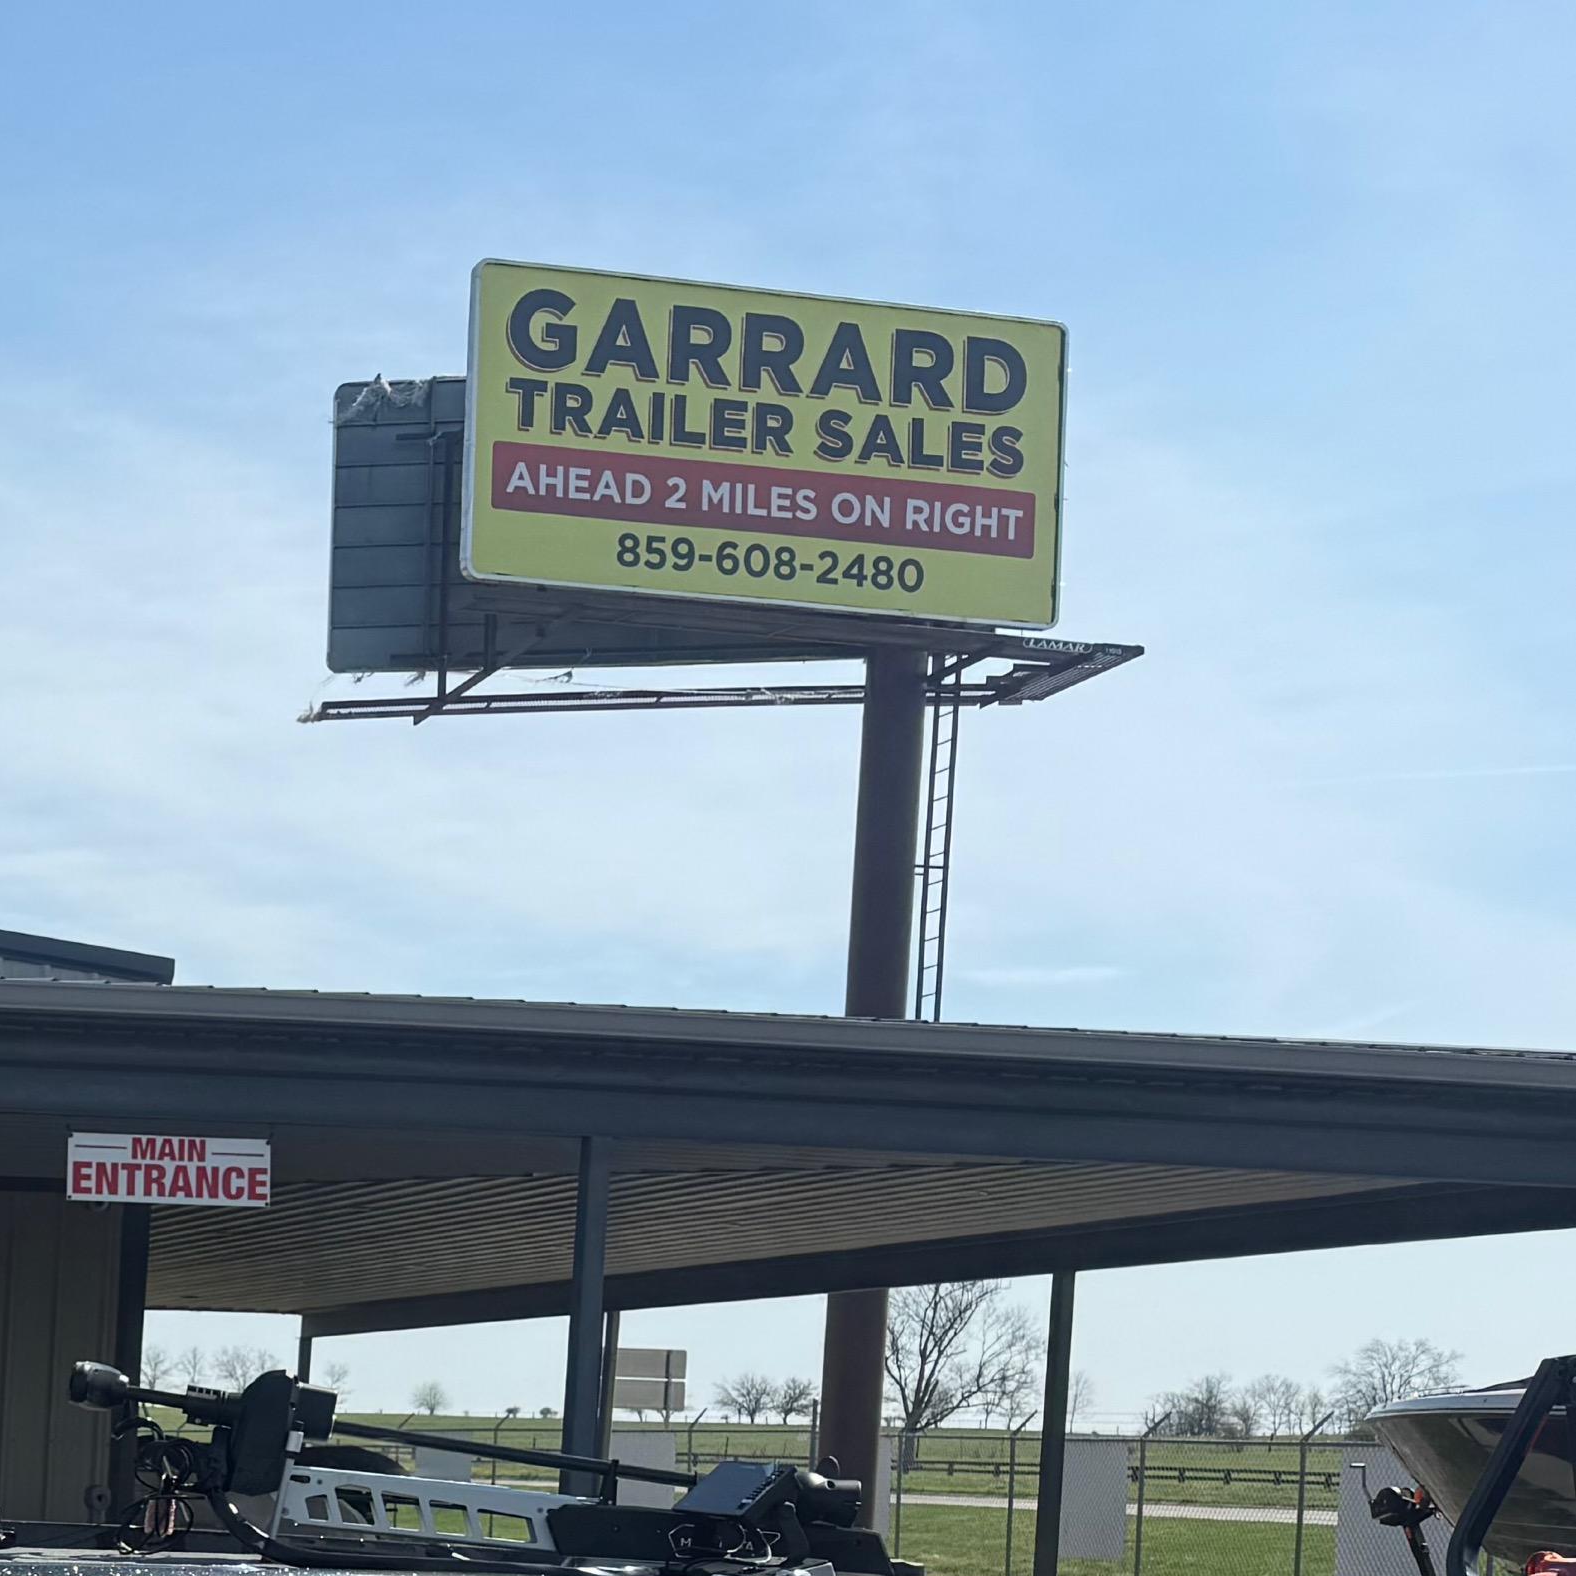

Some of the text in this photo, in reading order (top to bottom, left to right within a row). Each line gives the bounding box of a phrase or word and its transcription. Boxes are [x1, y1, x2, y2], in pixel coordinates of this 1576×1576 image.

[505, 287, 1029, 415] GARRARD
[505, 377, 1025, 478] TRAILER SALES
[505, 461, 1025, 542] AHEAD 2 MILES ON RIGHT
[616, 532, 925, 595] 859-608-2480
[1028, 638, 1086, 653] LAMAR
[71, 1160, 269, 1201] ENTRANCE
[131, 1136, 207, 1163] MAIN
